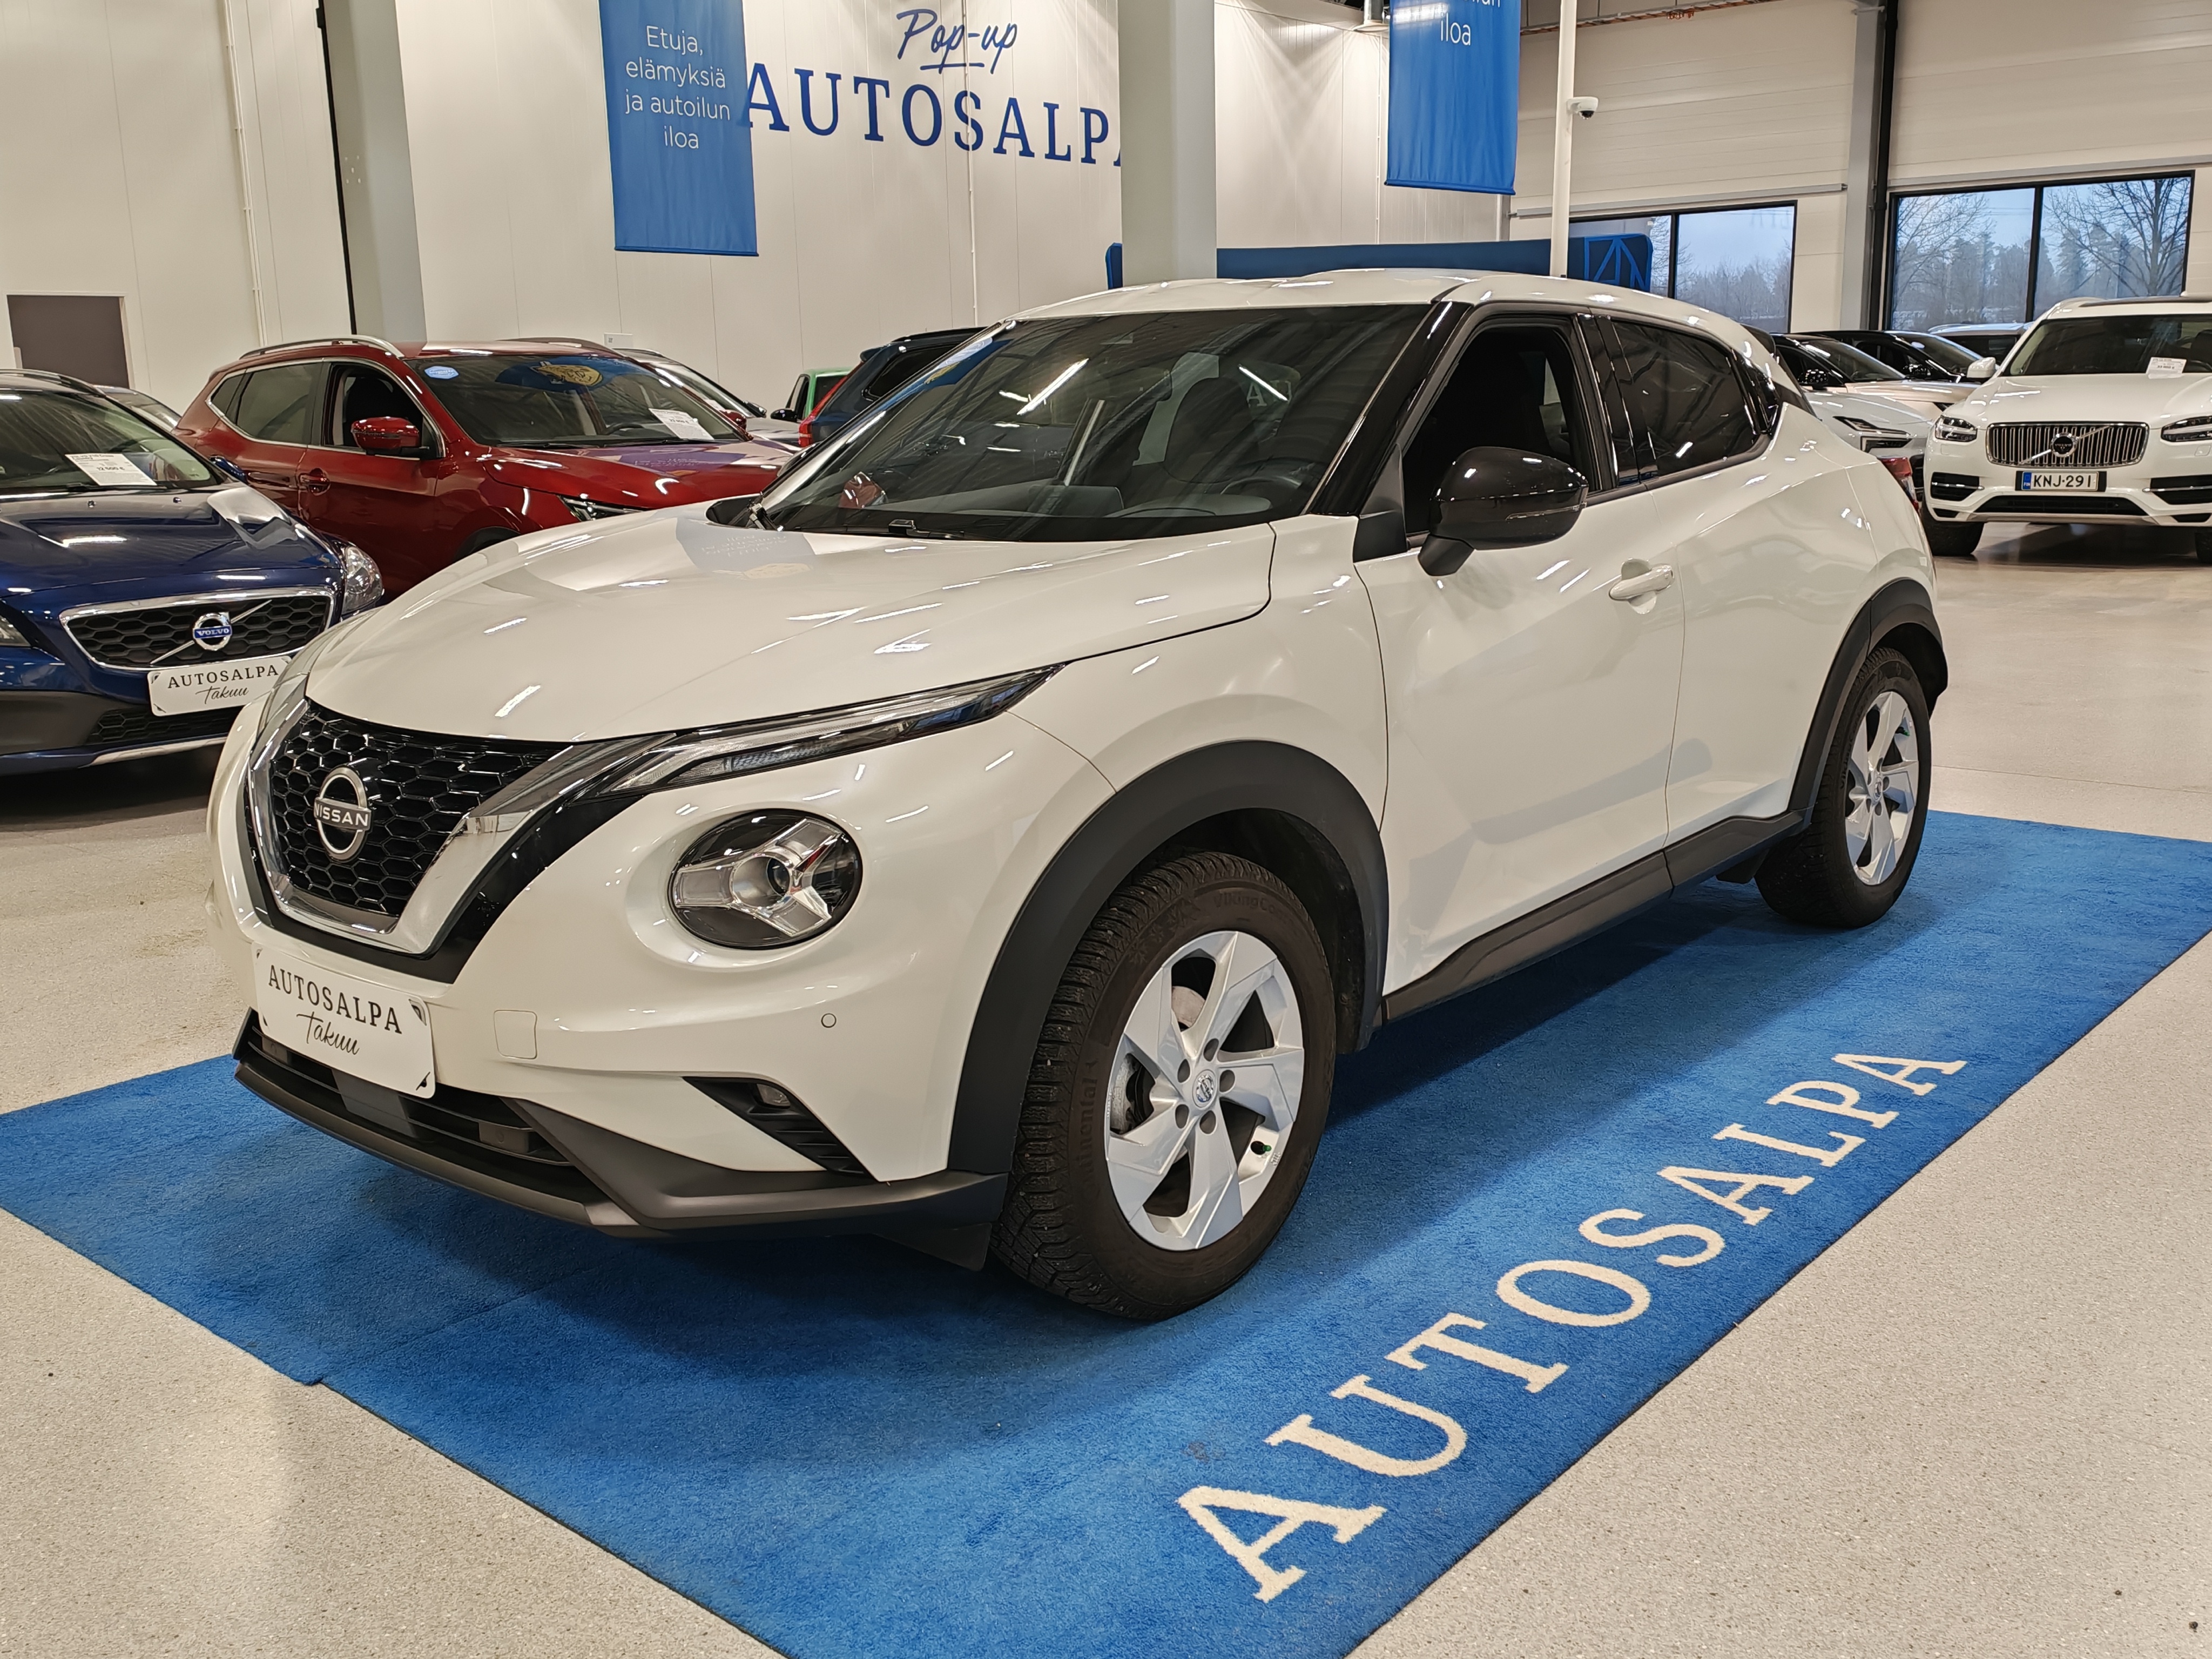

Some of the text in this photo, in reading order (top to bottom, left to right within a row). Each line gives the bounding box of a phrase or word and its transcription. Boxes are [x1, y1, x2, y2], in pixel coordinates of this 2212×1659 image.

[646, 25, 703, 56] Etuja,
[896, 9, 1017, 74] Pop-up
[1441, 12, 1471, 45] iloa
[625, 57, 726, 89] elämyksiä
[625, 89, 730, 120] ja autoilun
[742, 63, 1121, 167] AUTOSALP
[664, 125, 699, 149] iloa
[196, 628, 230, 637] VOLVO
[167, 665, 279, 689] AUTOSALPA
[195, 686, 249, 704] Takuu
[314, 802, 368, 827] NISSAN
[268, 965, 402, 1035] AUTOSALPA
[296, 1011, 360, 1055] Takuu
[1177, 1053, 1967, 1602] AUTOSALPA
